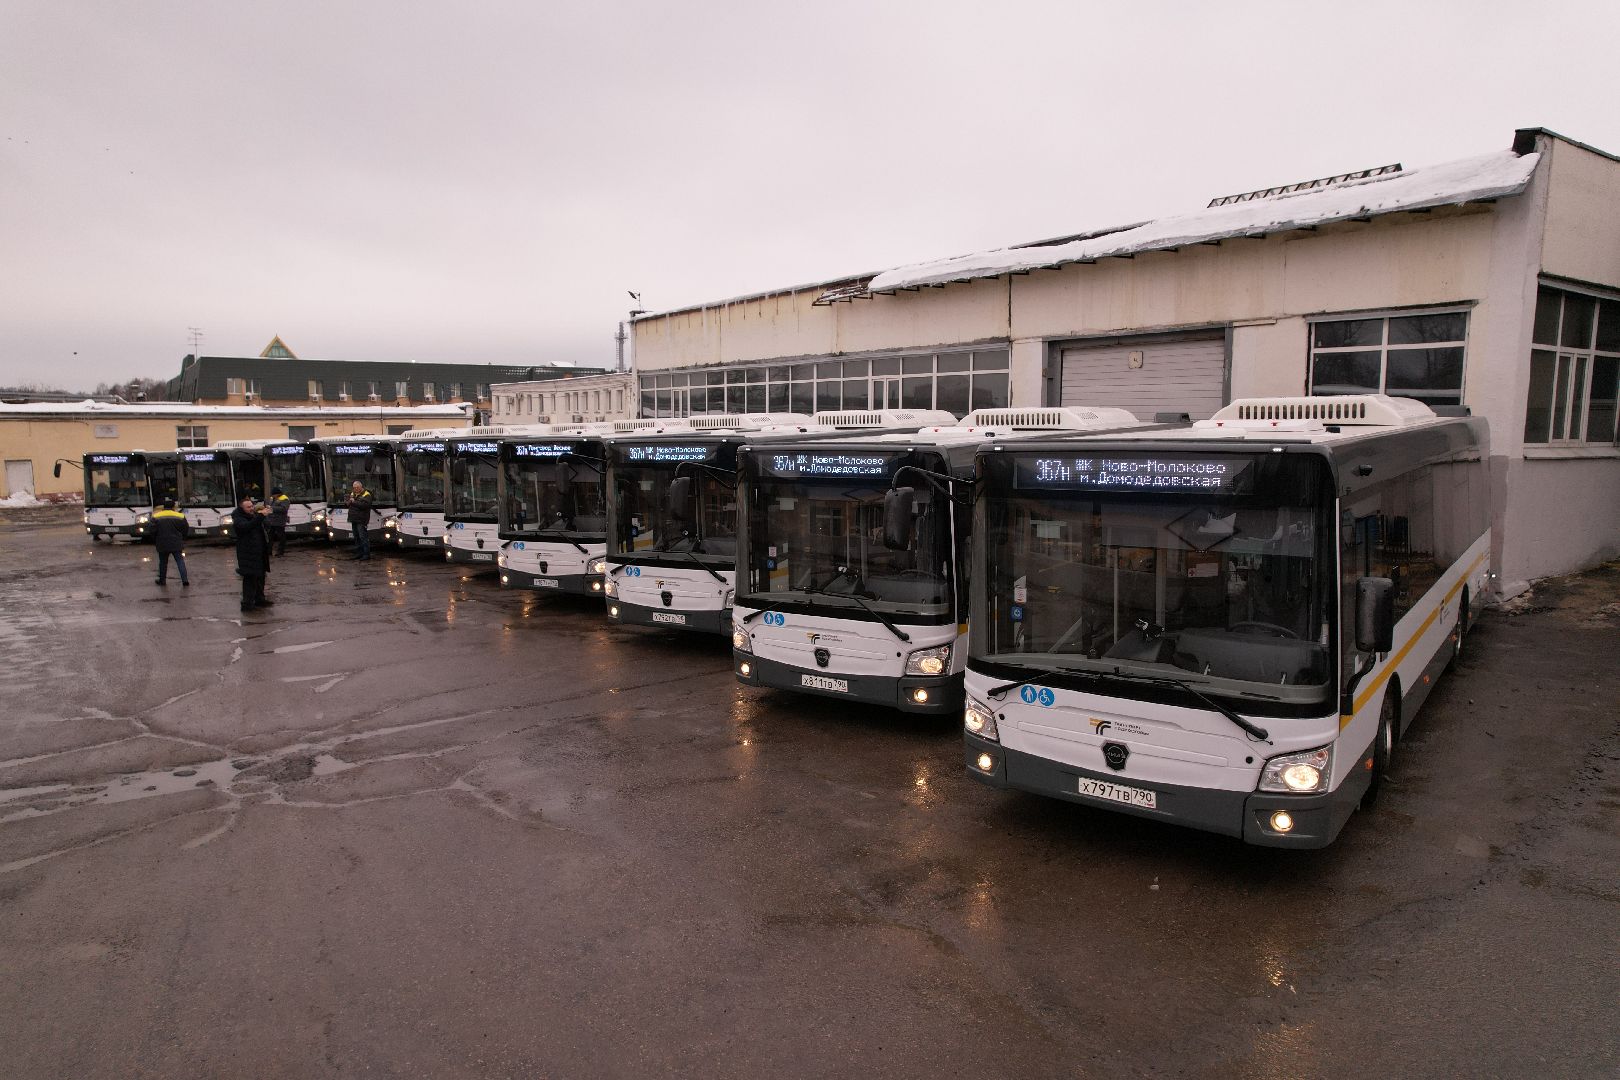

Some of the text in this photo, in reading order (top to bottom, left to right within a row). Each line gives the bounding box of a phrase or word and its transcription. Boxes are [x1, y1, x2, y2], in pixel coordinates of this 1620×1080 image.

[812, 455, 884, 465] Ново-Молоково
[1075, 459, 1226, 474] ЖК Ново-Молоково
[1132, 790, 1152, 802] 790
